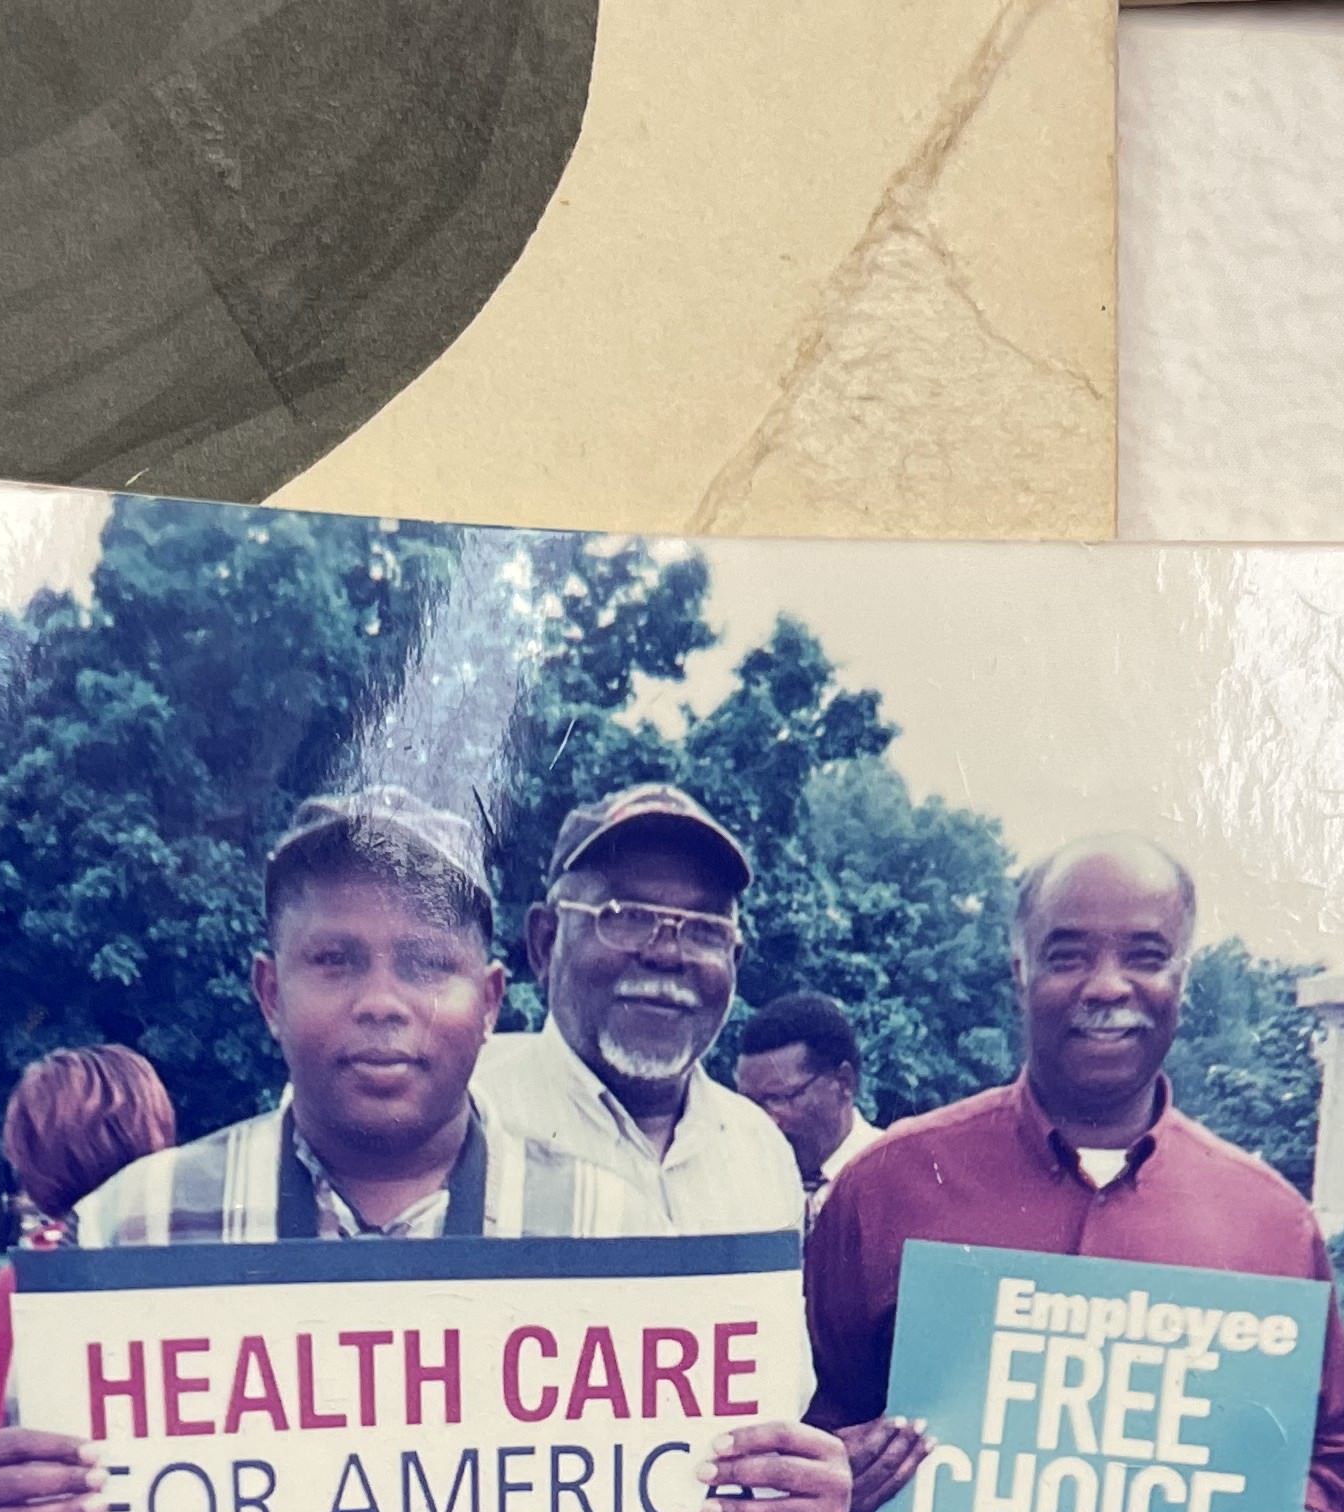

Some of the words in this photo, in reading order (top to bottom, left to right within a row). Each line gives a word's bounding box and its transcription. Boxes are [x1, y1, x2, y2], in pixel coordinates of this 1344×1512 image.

[994, 1277, 1298, 1356] Employee
[86, 1328, 460, 1440] HEALTH
[502, 1321, 760, 1424] CARE
[981, 1331, 1219, 1465] FREE
